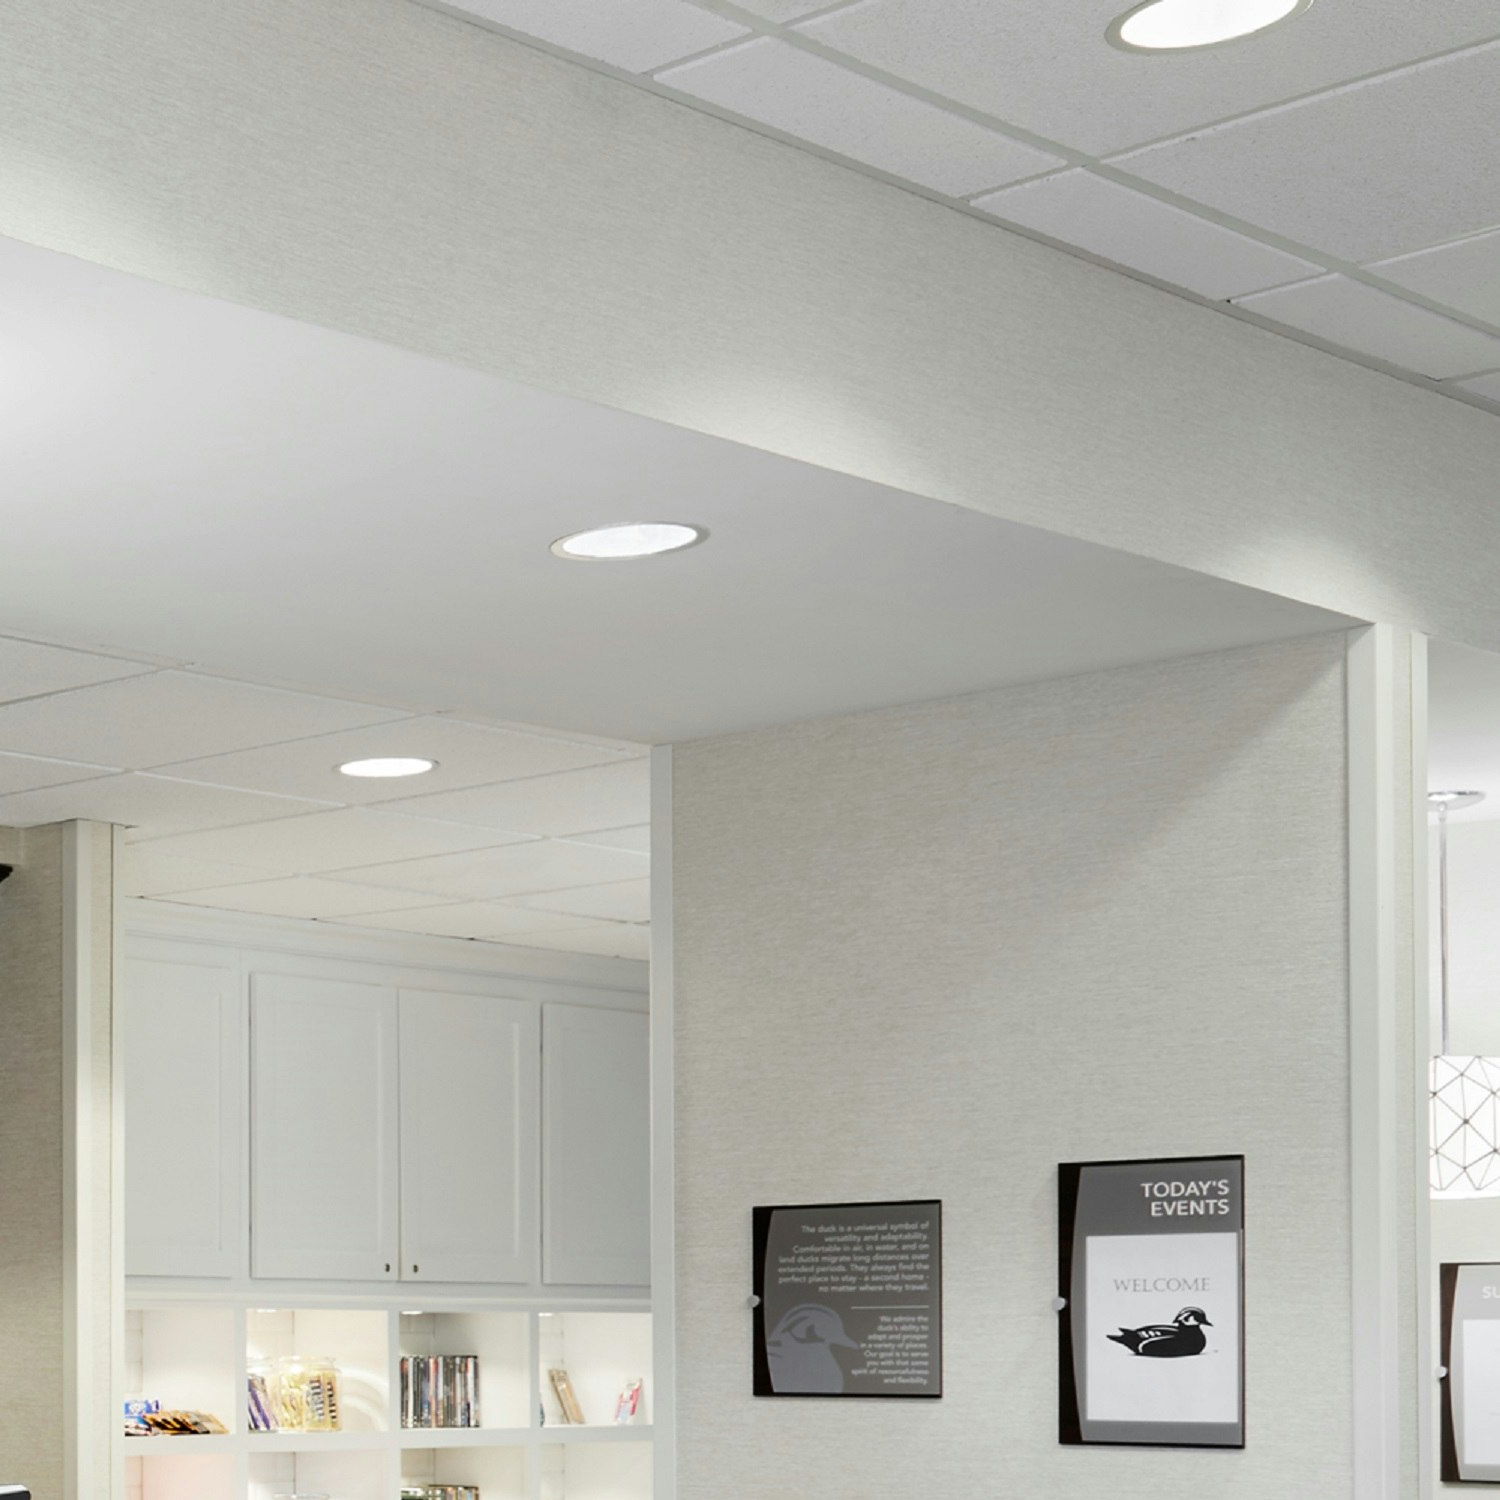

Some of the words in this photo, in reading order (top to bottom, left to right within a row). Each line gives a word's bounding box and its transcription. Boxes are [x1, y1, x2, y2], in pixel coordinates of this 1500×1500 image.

[1140, 1179, 1230, 1198] TODAY'S
[1150, 1199, 1230, 1217] EVENTS
[801, 1225, 816, 1233] The
[817, 1224, 836, 1232] duck
[854, 1223, 888, 1232] universal
[890, 1221, 918, 1233] symbol
[824, 1233, 861, 1243] versatility
[863, 1233, 878, 1242] and
[792, 1245, 841, 1254] Comfortable
[902, 1242, 917, 1250] and
[797, 1255, 819, 1263] ducks
[821, 1255, 851, 1264] migrate
[852, 1254, 871, 1263] long
[872, 1253, 909, 1261] distances
[778, 1265, 814, 1273] extended
[850, 1263, 869, 1273] They
[870, 1264, 896, 1273] always
[898, 1262, 914, 1270] find
[778, 1275, 806, 1284] perfect
[808, 1275, 829, 1284] place
[871, 1273, 899, 1281] second
[885, 1283, 903, 1293] they
[1112, 1277, 1211, 1293] WELCOME
